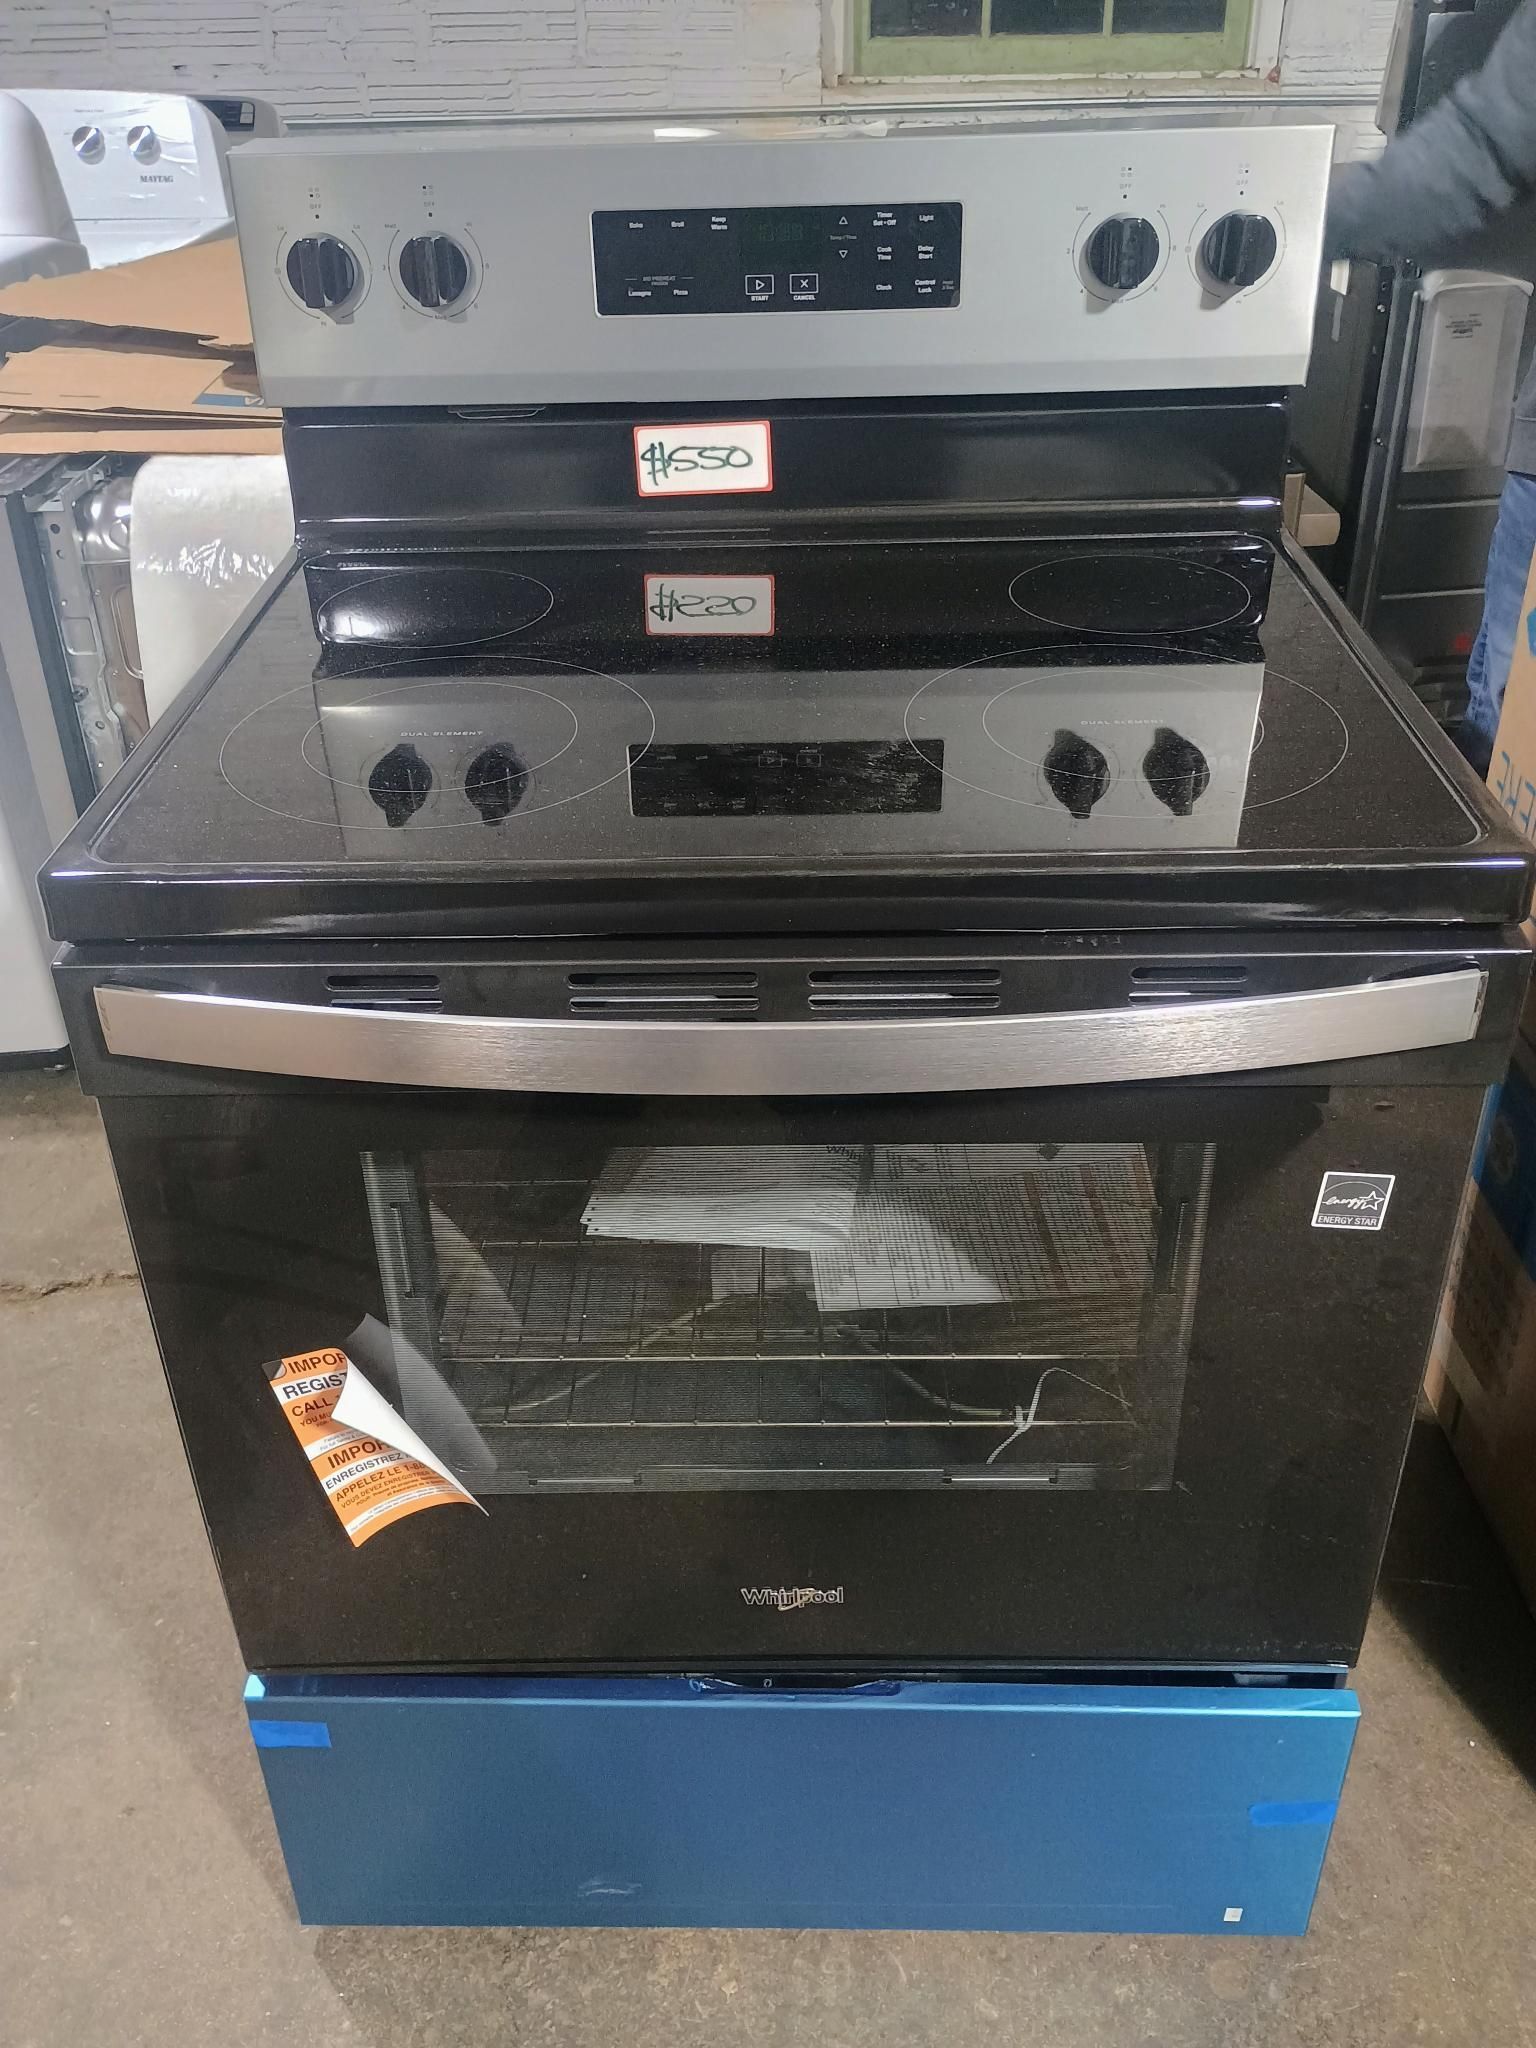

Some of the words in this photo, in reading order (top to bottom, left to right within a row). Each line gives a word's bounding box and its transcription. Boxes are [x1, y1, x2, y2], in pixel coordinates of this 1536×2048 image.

[140, 175, 174, 183] MAYTAG
[641, 441, 753, 486] $550
[1318, 1216, 1354, 1224] ENERGY
[1354, 1217, 1377, 1226] STAR
[292, 1398, 333, 1416] CALL
[300, 1416, 318, 1427] YOU
[326, 1452, 404, 1489] ENREGISTREZ
[336, 1472, 386, 1502] APPELEZ
[386, 1466, 402, 1476] LE
[341, 1495, 360, 1509] VOUS
[360, 1482, 382, 1496] DEVEZ
[740, 1586, 844, 1611] Whirlpool
